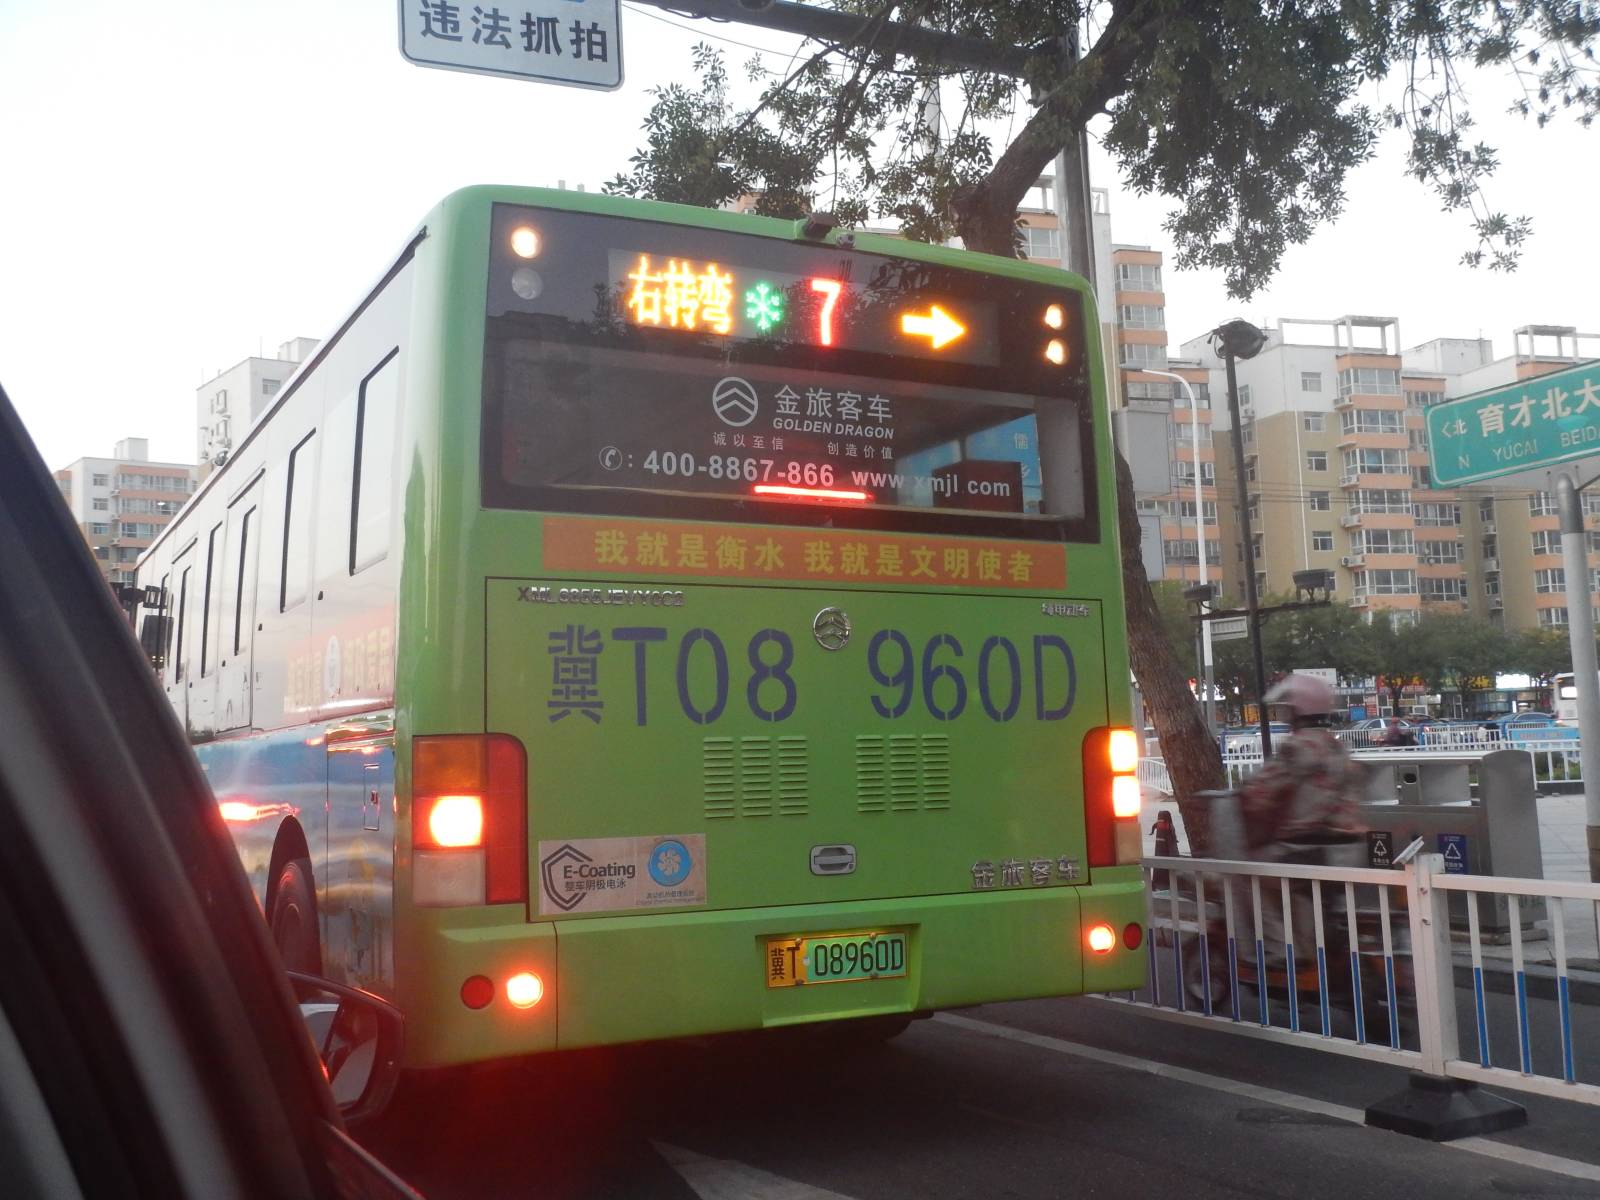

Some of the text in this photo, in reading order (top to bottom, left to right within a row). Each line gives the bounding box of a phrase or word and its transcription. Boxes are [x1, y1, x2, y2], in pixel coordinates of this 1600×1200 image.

[419, 0, 608, 63] 违法抓拍
[628, 254, 734, 334] 右转弯
[811, 277, 842, 346] 7
[773, 384, 893, 424] 金旅客车
[712, 431, 894, 460] 诚以至信 创造价值
[772, 417, 895, 440] GOLDEN DRAGON
[1560, 425, 1600, 448] BEID
[643, 449, 834, 488] 400-8867-866
[594, 528, 1035, 583] 我就是衡水 我就是文明使者
[867, 628, 1077, 722] 960D
[563, 861, 637, 880] E-Coating
